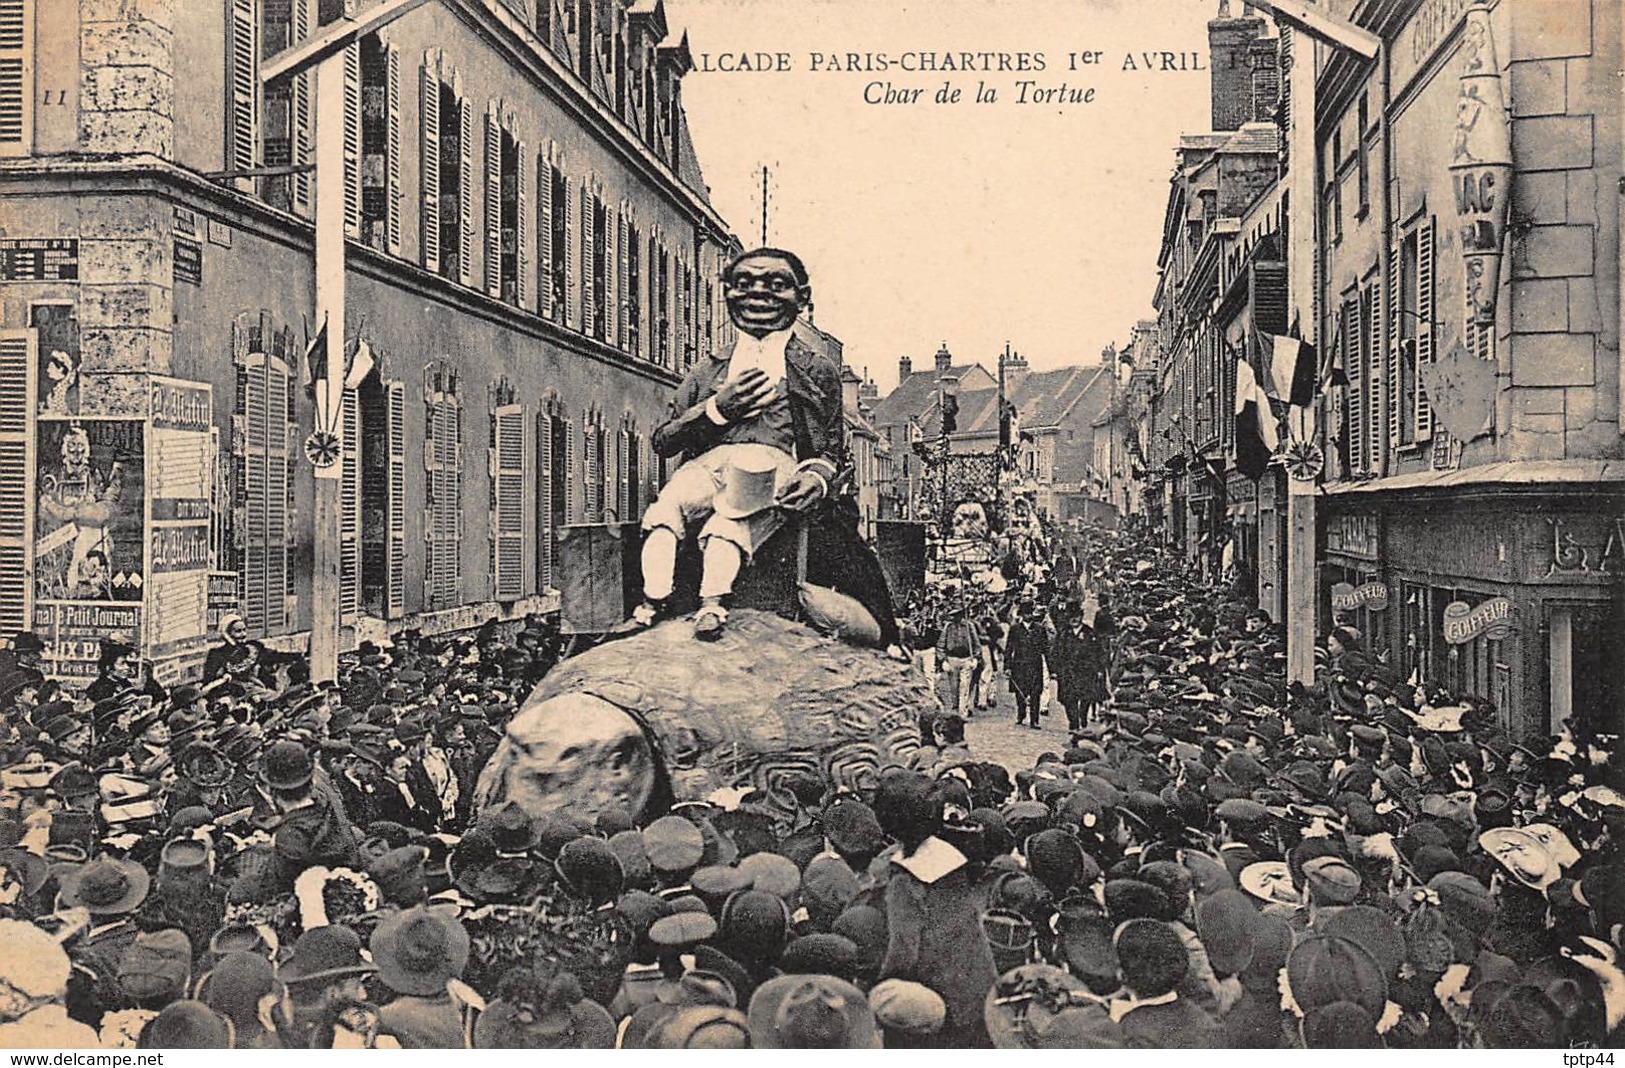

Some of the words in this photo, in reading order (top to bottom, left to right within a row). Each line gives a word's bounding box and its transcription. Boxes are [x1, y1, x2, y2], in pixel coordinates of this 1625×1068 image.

[1333, 585, 1388, 607] COIFFEUR
[66, 606, 91, 626] Petit
[92, 607, 138, 627] Journal
[1448, 601, 1509, 640] COIFFEUR
